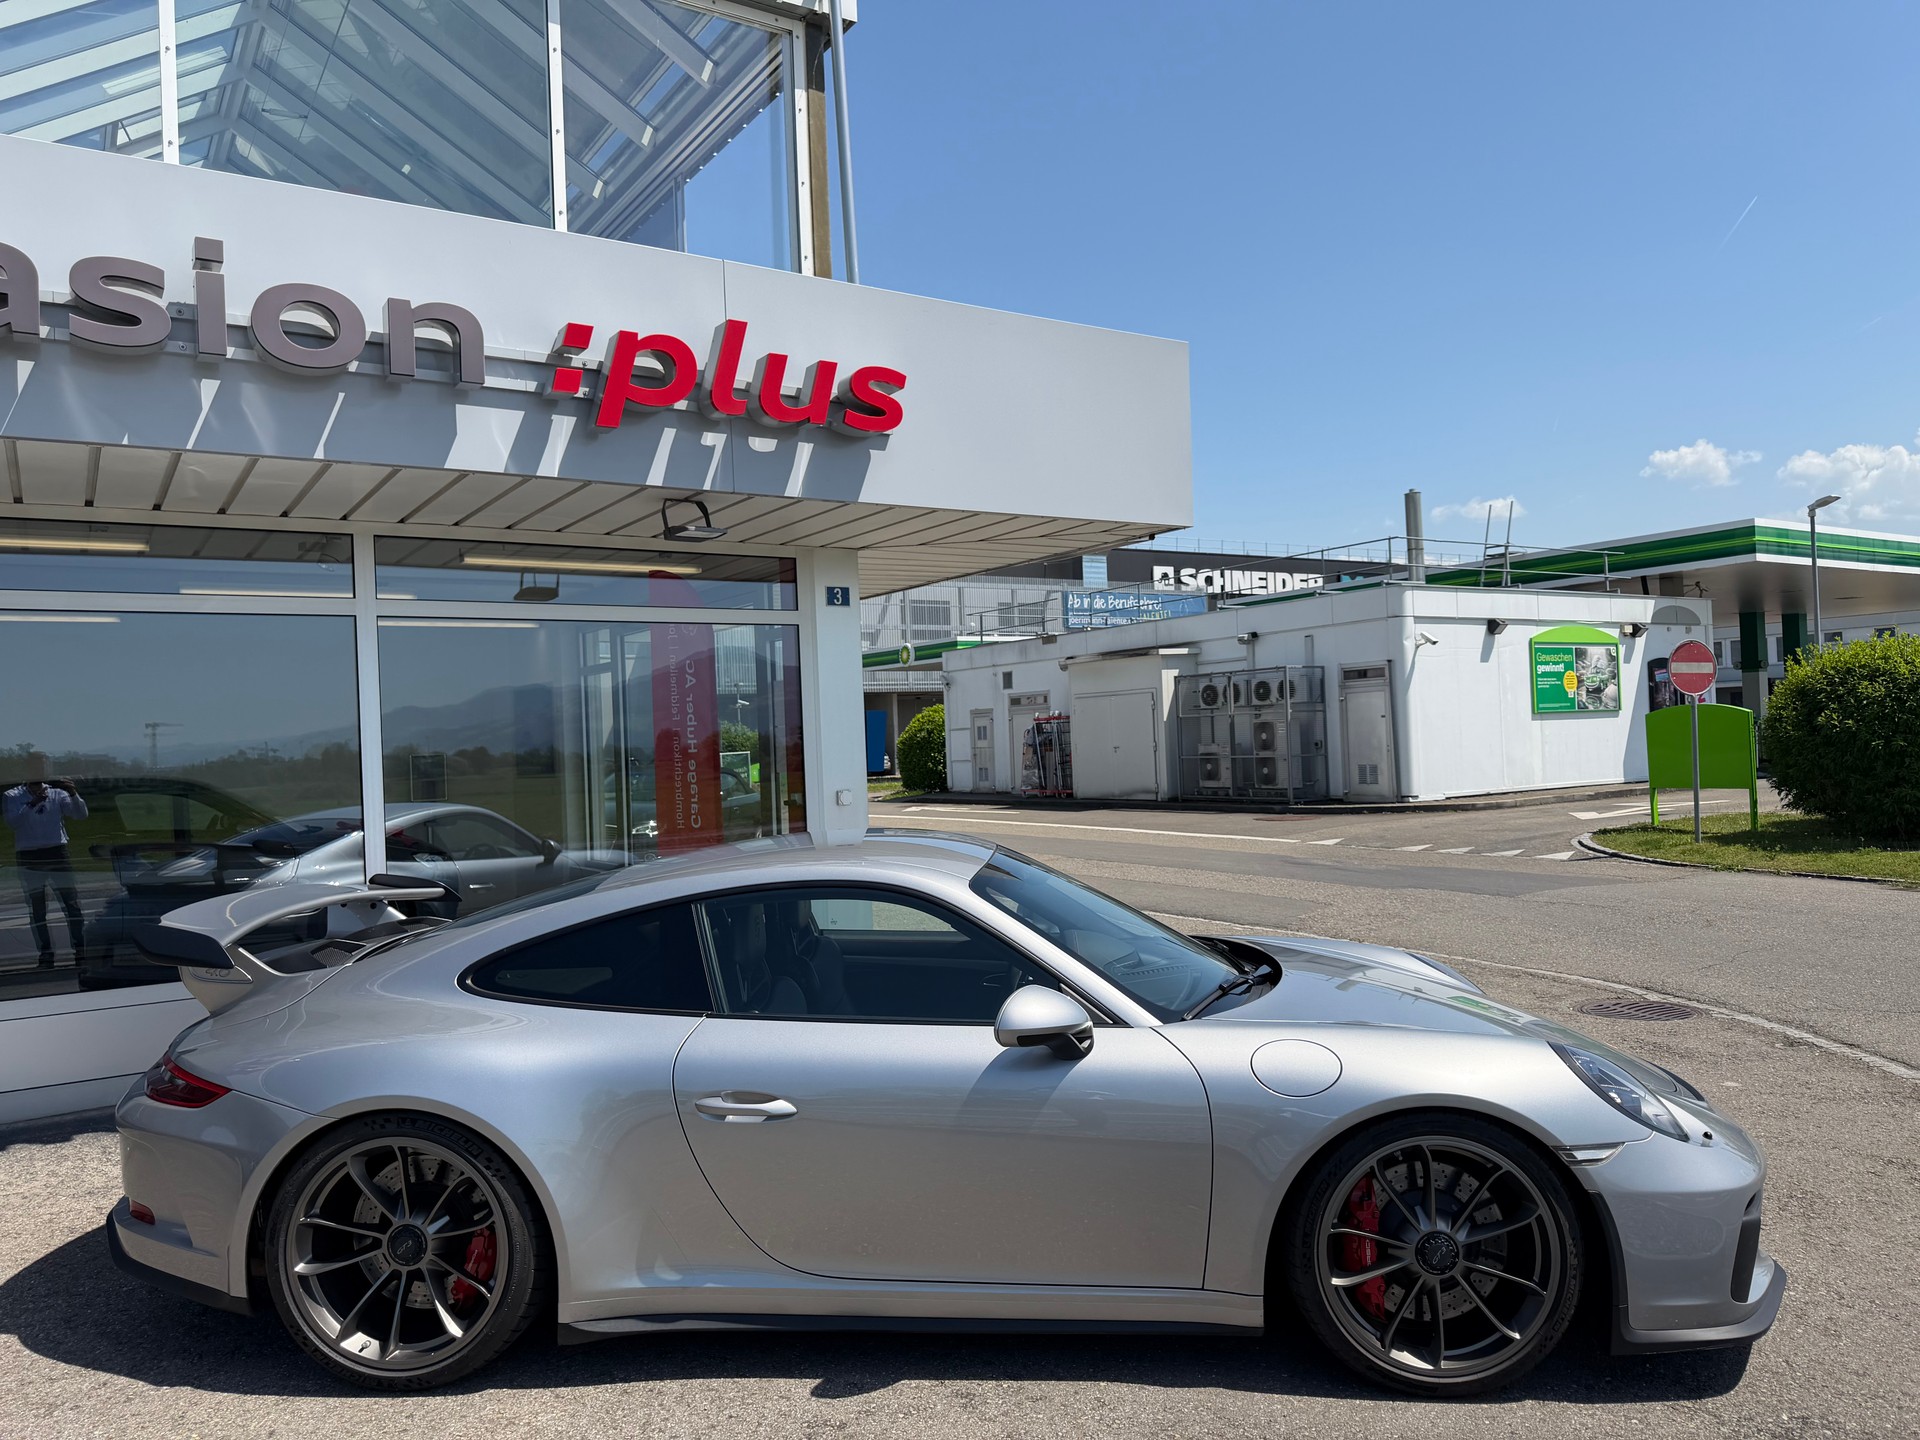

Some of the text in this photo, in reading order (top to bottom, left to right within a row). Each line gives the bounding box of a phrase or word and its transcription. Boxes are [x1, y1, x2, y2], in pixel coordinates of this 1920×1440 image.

[551, 319, 907, 433] :plus
[833, 587, 843, 605] 3
[1068, 593, 1162, 610] Ab in die Berufsehre!
[1536, 652, 1573, 662] Gewaschen
[1536, 662, 1565, 674] gewinnt!
[414, 1119, 483, 1157] MICHELIN
[396, 1239, 412, 1255] GT3
